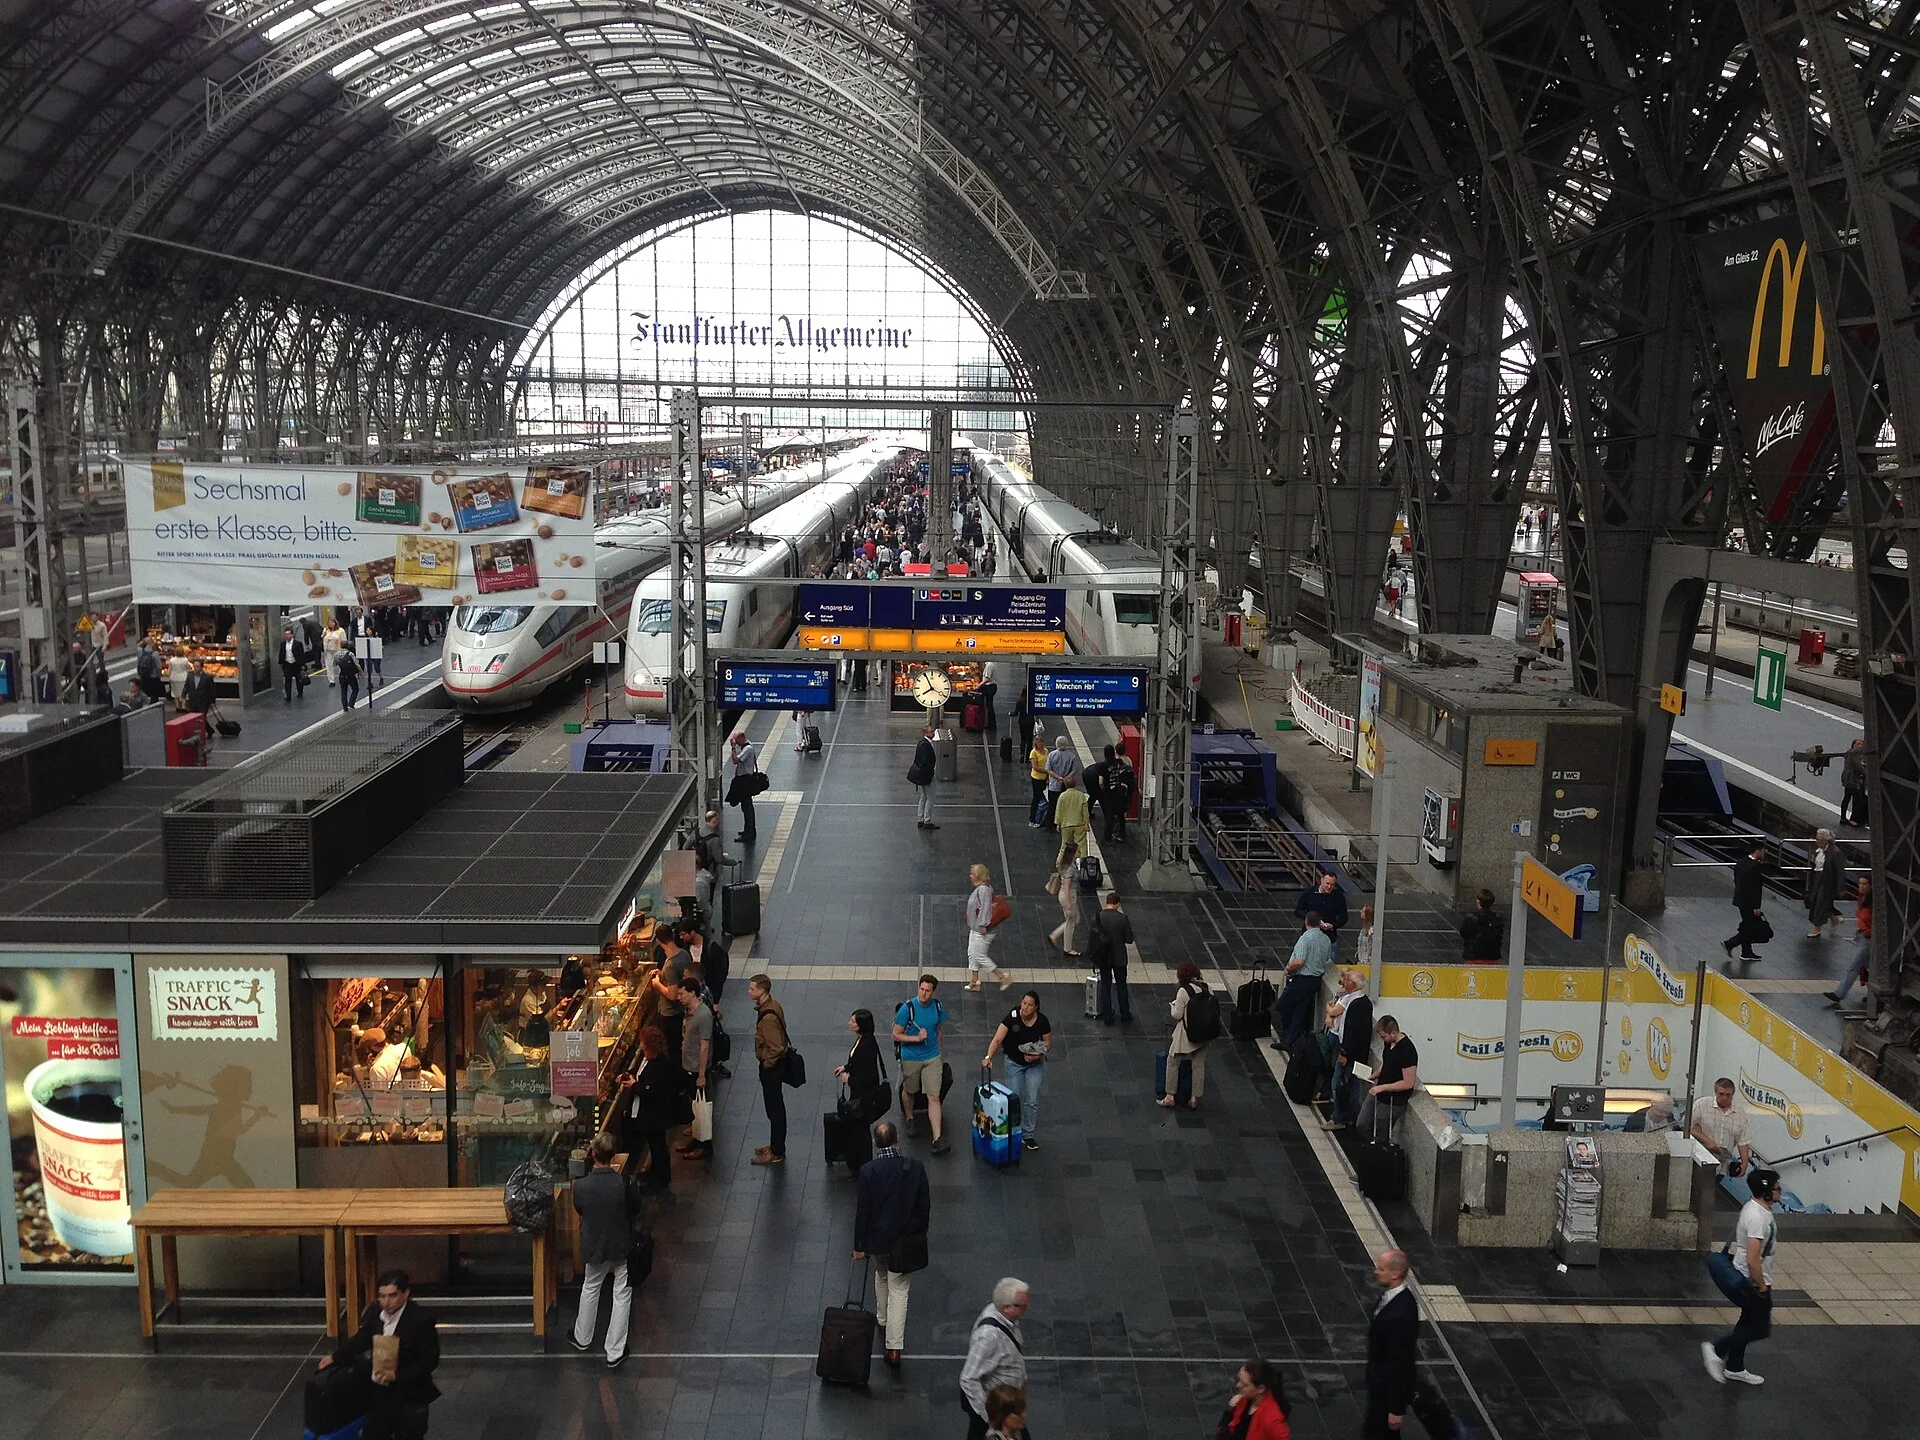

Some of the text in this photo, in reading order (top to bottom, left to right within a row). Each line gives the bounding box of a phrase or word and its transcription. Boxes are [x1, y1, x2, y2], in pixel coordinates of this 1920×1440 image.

[1724, 250, 1759, 267] Am Gleis 22
[630, 312, 912, 353] Frankfurter Allgemeine
[193, 474, 306, 500] Sechsmal
[155, 514, 357, 544] erste Klasse, bitte.
[920, 590, 928, 600] U
[974, 591, 982, 600] S
[725, 669, 732, 680] 8
[1131, 676, 1139, 688] 9
[40, 673, 49, 698] 7
[1640, 950, 1654, 970] rail
[1656, 963, 1661, 980] &
[1663, 972, 1684, 998] fresh
[166, 980, 231, 993] TRAFFIC
[167, 996, 233, 1011] SNACK
[17, 1021, 42, 1034] Mein
[172, 1017, 192, 1027] home
[193, 1018, 212, 1027] made
[220, 1017, 237, 1026] with
[238, 1016, 254, 1026] love
[62, 1044, 76, 1058] für
[77, 1044, 90, 1055] die
[1462, 1034, 1578, 1055] rail & resh WC
[1650, 1023, 1671, 1072] WC
[1741, 1079, 1755, 1099] rail
[1757, 1090, 1763, 1103] &
[1765, 1092, 1786, 1113] fresh
[43, 1152, 93, 1186] SNACK
[80, 1190, 97, 1198] with
[98, 1190, 115, 1200] love
